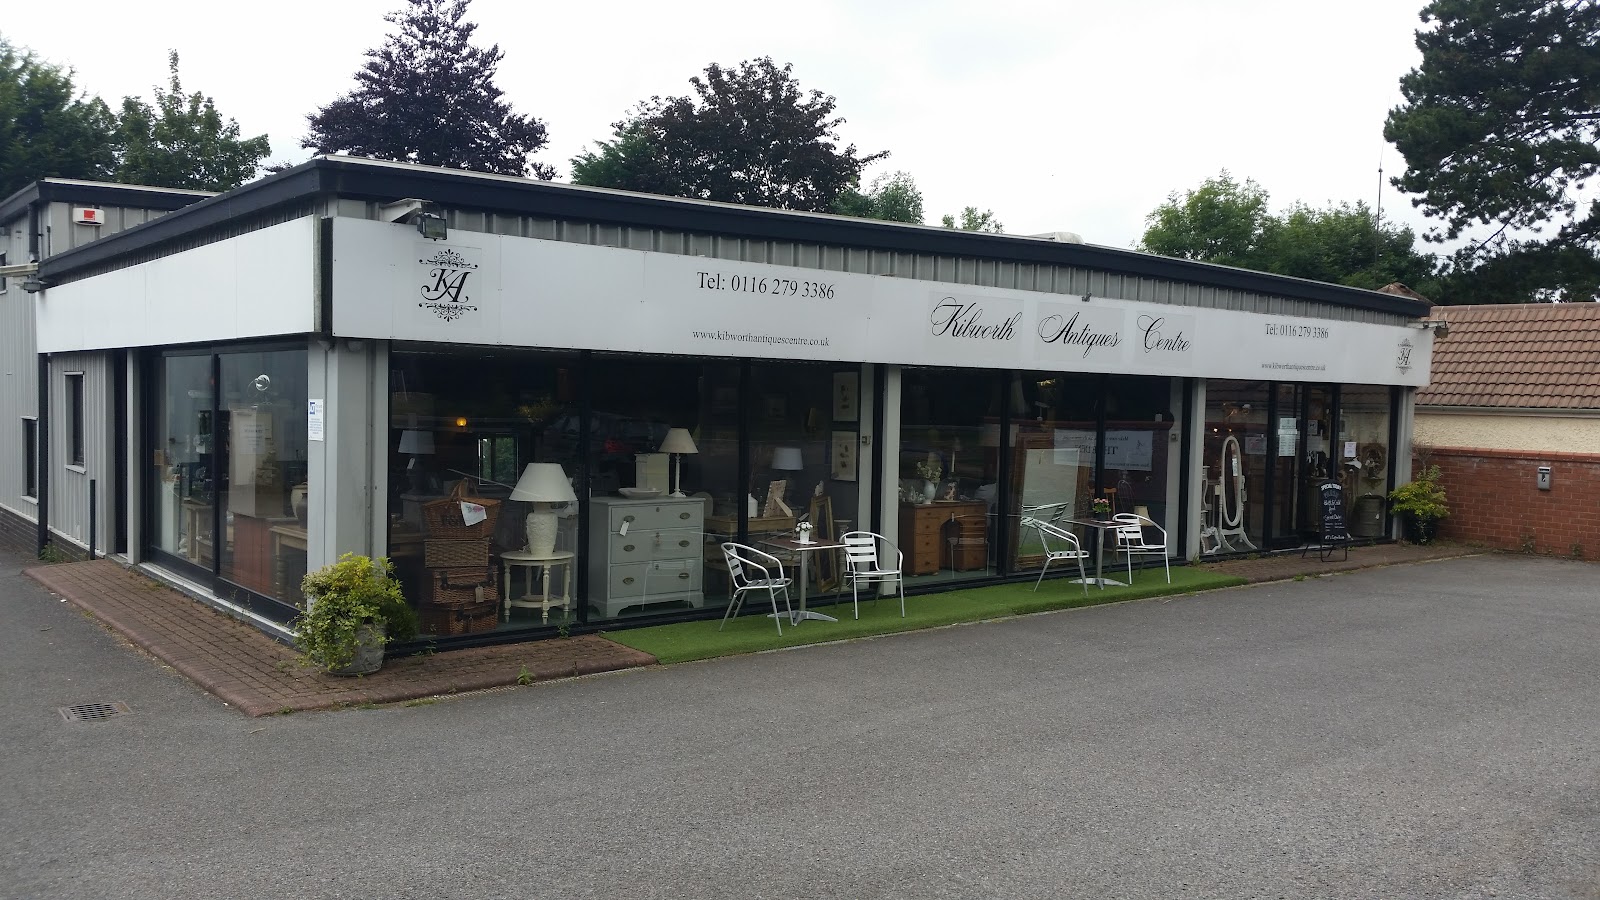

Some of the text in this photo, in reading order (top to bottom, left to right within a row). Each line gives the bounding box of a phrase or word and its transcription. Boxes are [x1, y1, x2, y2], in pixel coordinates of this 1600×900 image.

[697, 271, 835, 300] Tel: 0116 279 3386
[692, 330, 830, 346] www.kibworthantiquescentre.co.uk
[931, 297, 1191, 359] Kibworth Antiques Centre
[1265, 323, 1329, 339] Tel: 0116 279 3386
